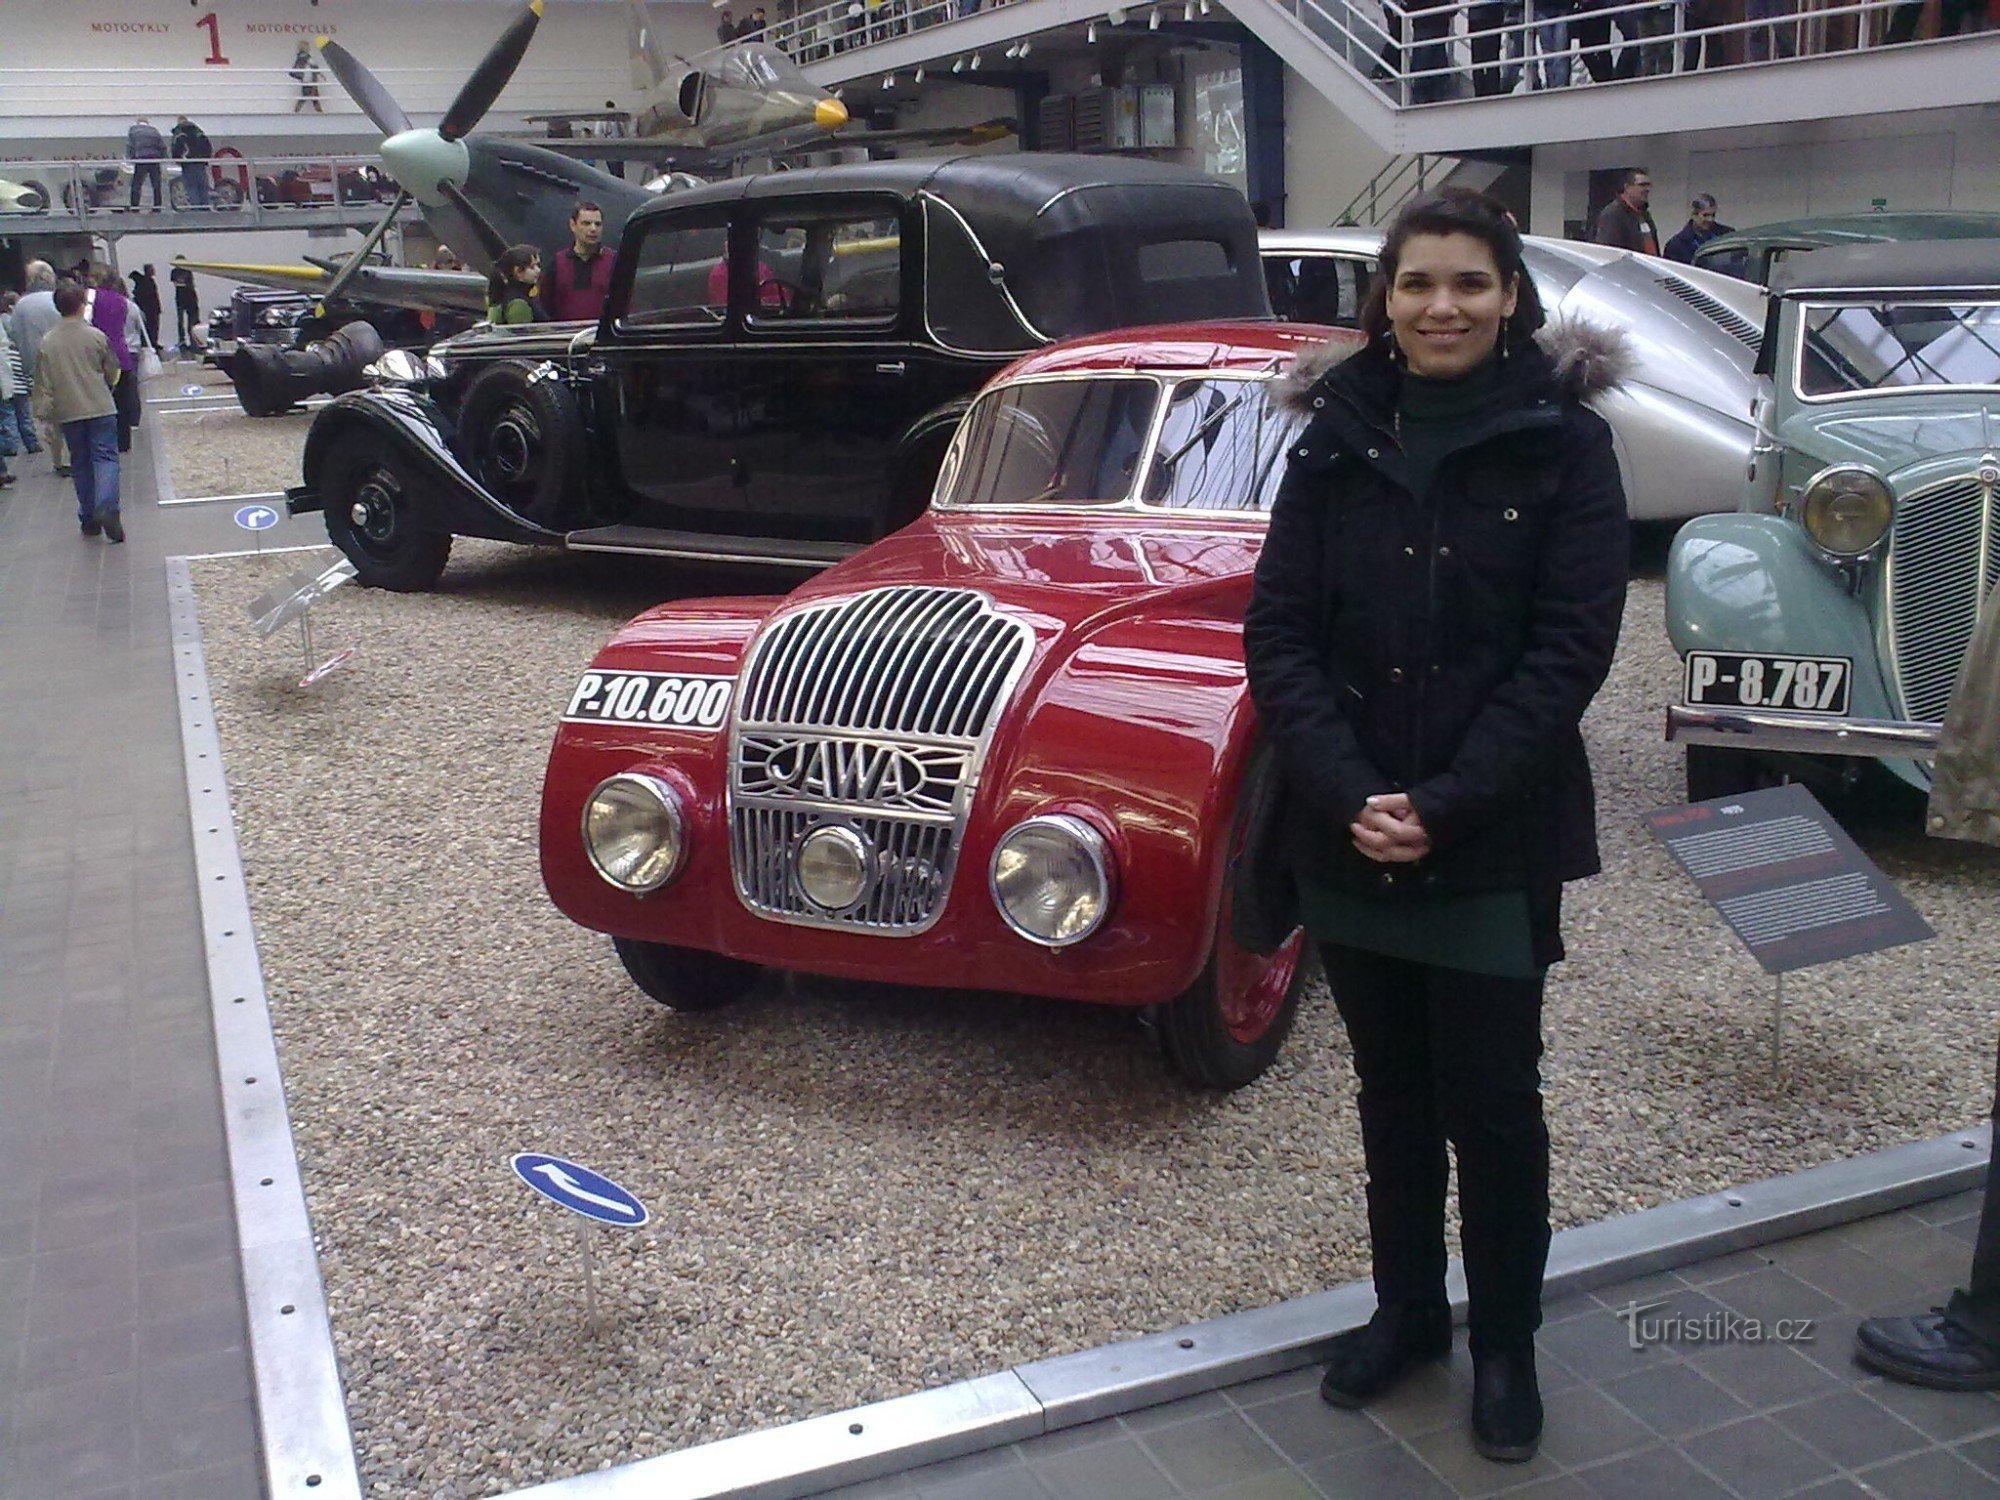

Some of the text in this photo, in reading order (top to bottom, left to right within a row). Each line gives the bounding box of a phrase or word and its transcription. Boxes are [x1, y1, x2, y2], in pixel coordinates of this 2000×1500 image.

[91, 12, 338, 65] MOTOCYKLY 1 MOTORCYCLES
[565, 673, 732, 726] P-10.600
[1690, 656, 1844, 710] P-8.787
[771, 740, 906, 802] JAWA
